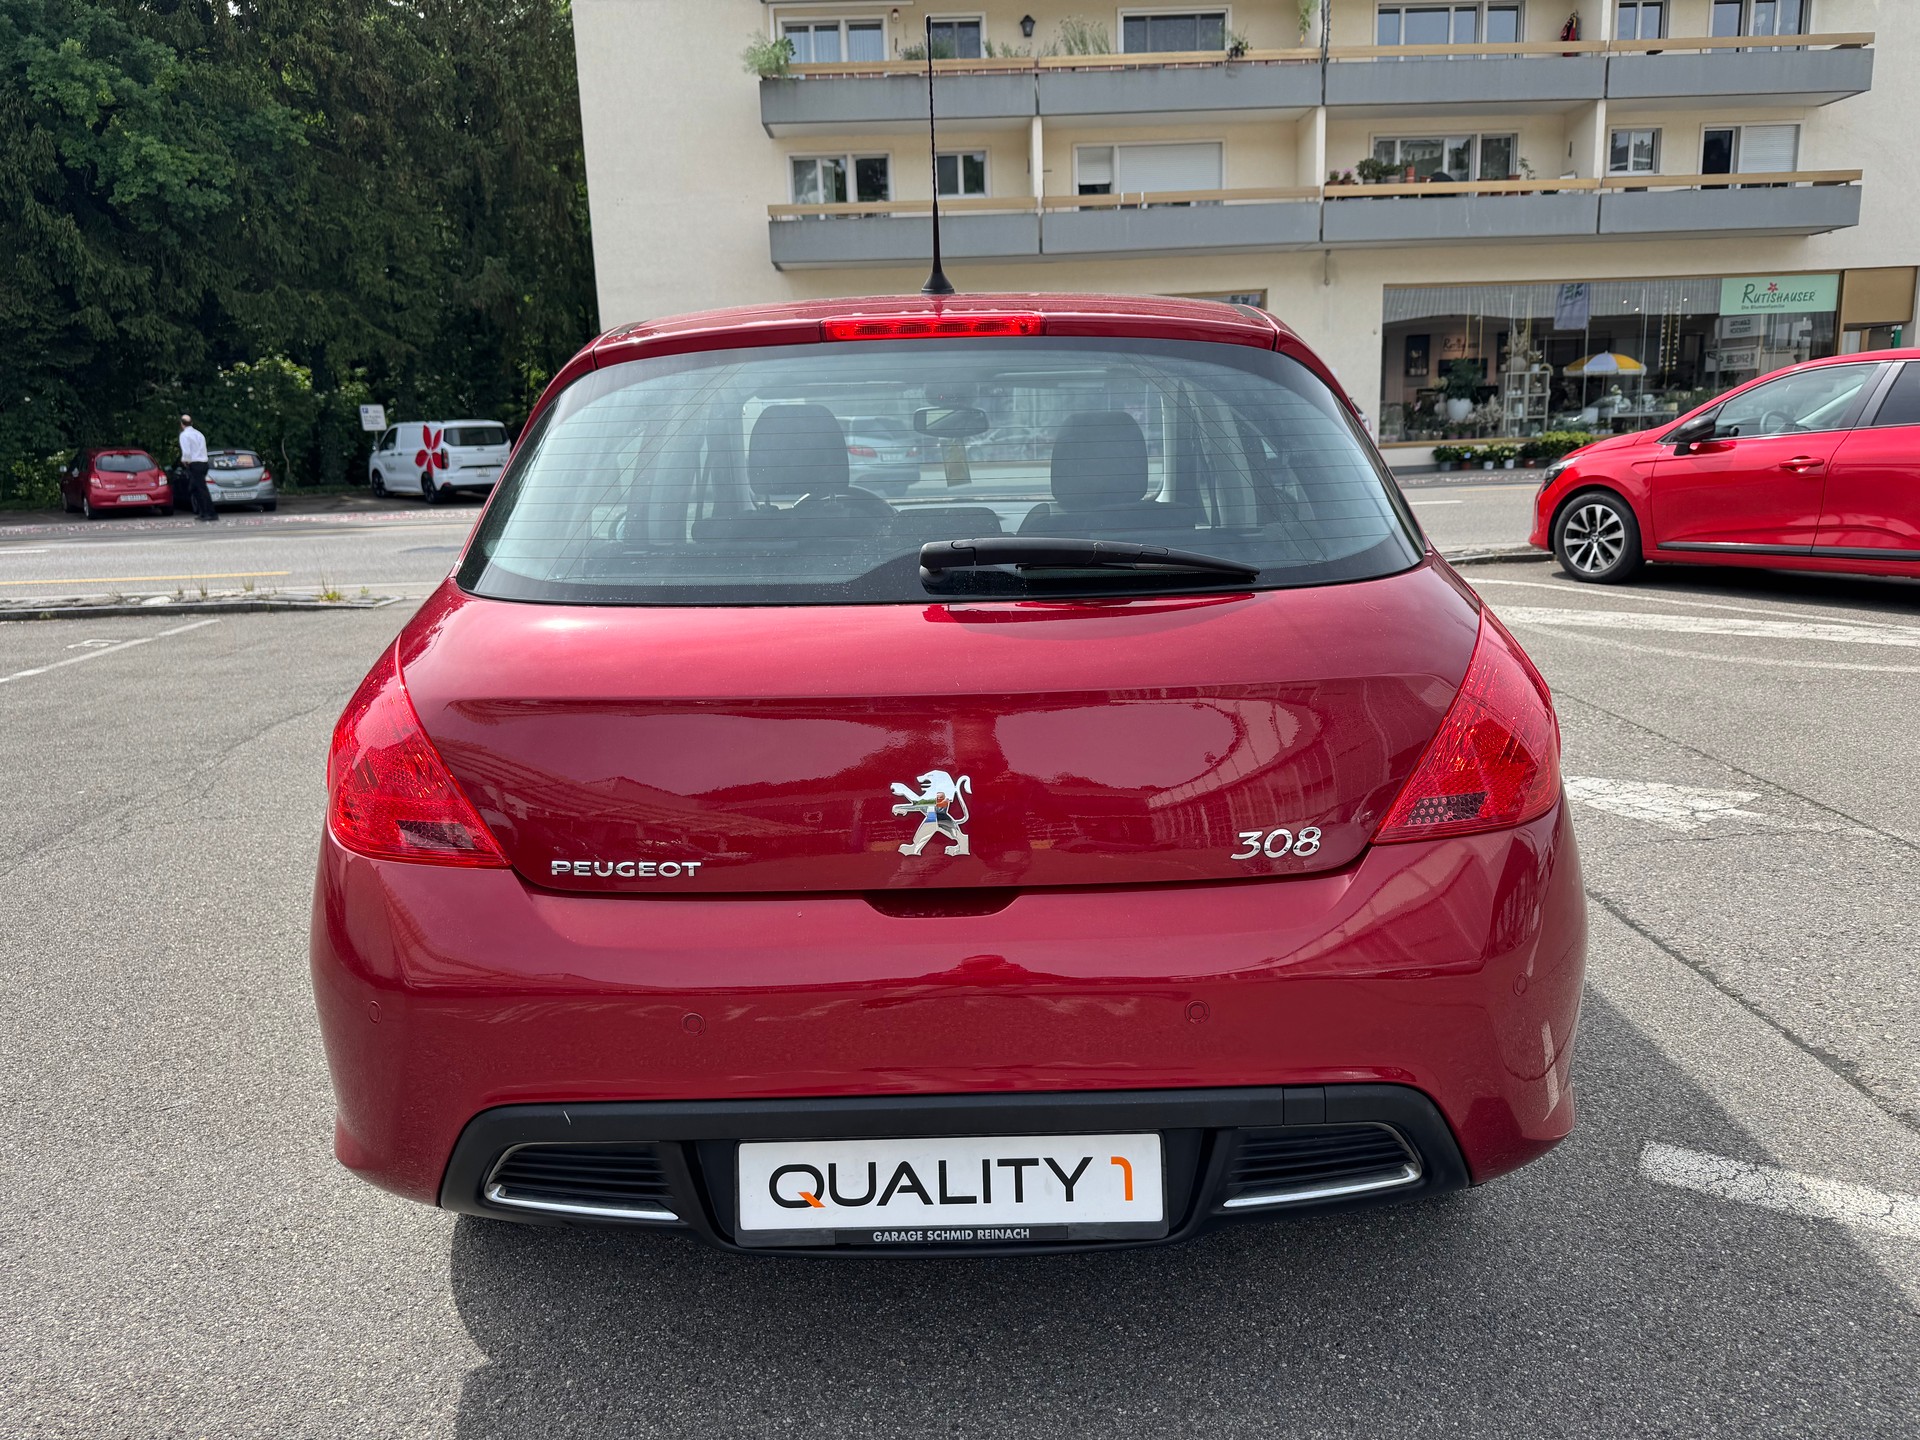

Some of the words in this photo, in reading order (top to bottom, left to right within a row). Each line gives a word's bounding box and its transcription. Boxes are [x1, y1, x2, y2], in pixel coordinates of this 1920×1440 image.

[1230, 826, 1322, 860] 308
[551, 860, 702, 878] PEUGEOT
[768, 1156, 1094, 1209] QUALITY
[1110, 1155, 1134, 1202] 1
[872, 1231, 923, 1242] GARAGE
[926, 1230, 974, 1241] SCHMID
[977, 1228, 1030, 1240] REINACH
